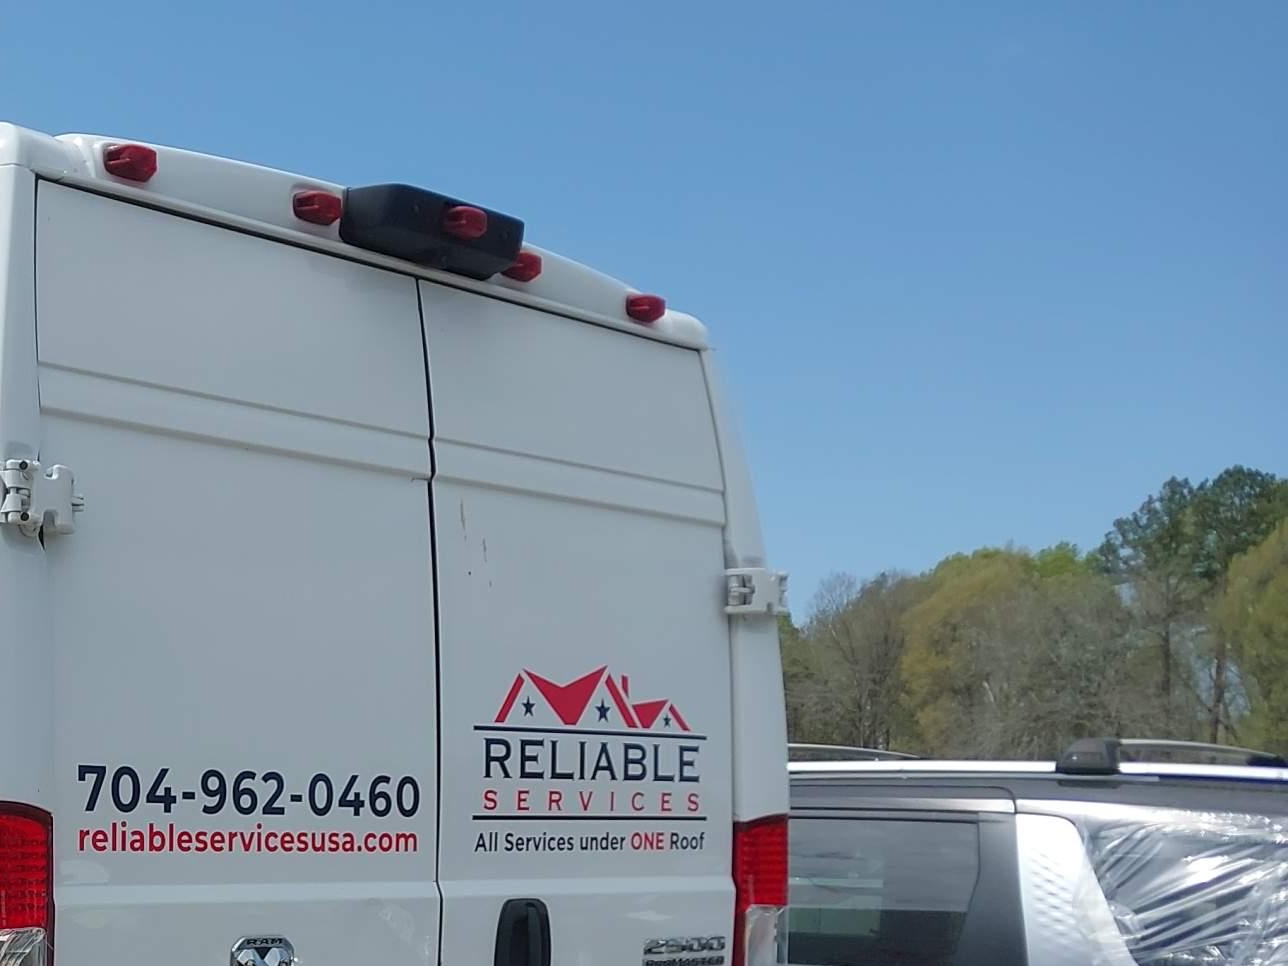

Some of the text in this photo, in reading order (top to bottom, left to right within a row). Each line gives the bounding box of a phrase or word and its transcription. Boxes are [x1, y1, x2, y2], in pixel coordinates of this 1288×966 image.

[483, 737, 700, 783] RELIABLE
[77, 764, 421, 818] 704-962-0460
[483, 789, 700, 812] SERVICES
[78, 820, 419, 853] reliableservicesusa.com
[474, 831, 706, 852] All Services under ONE Roof
